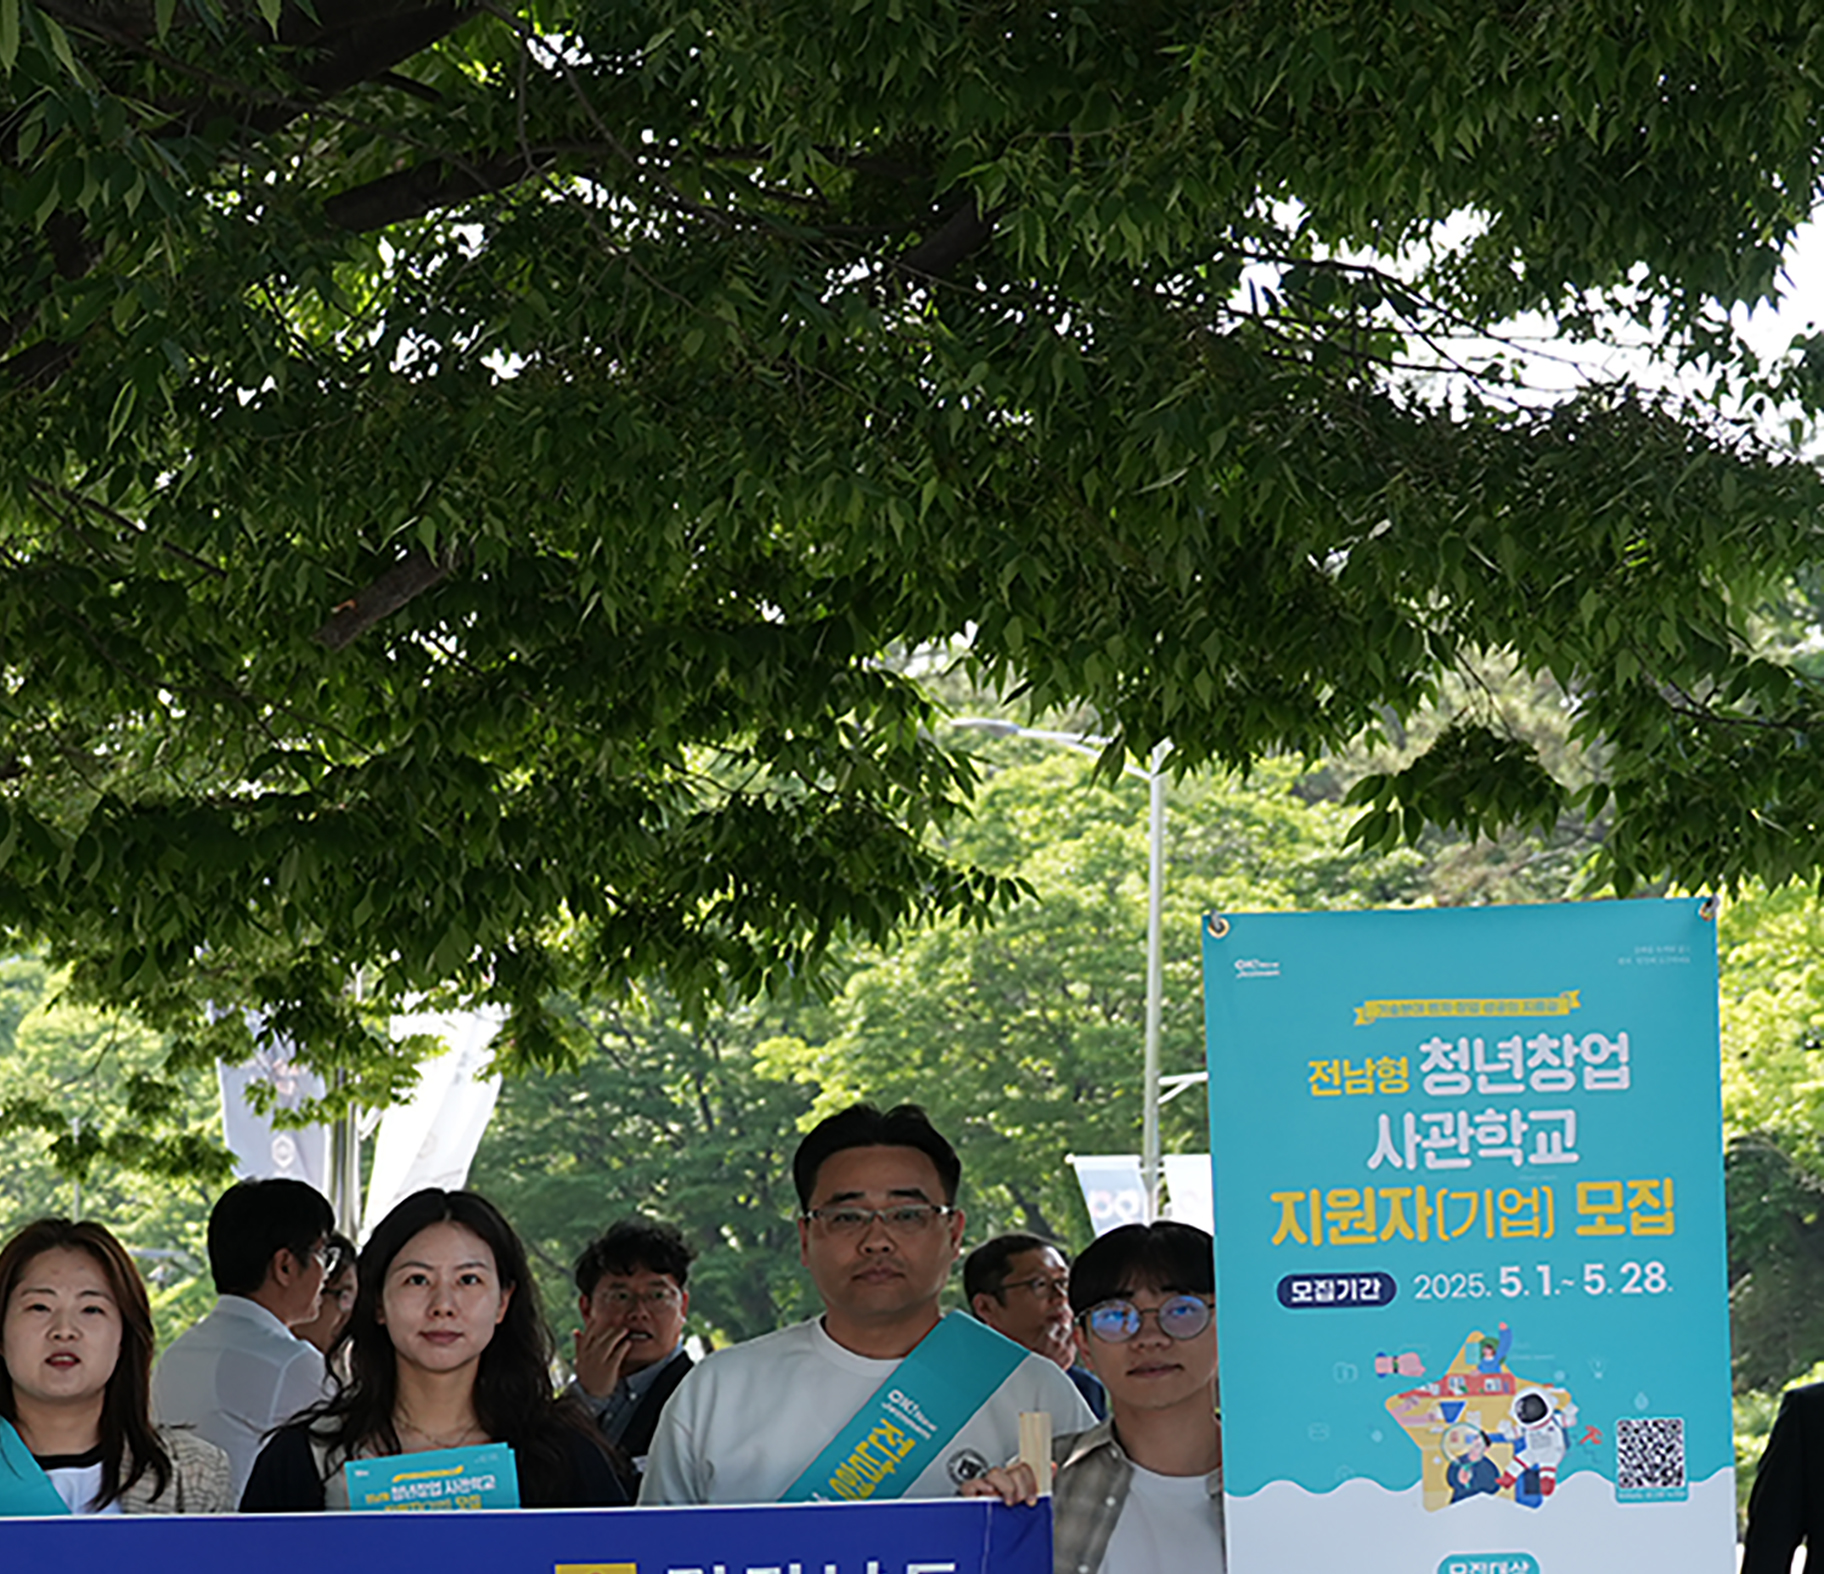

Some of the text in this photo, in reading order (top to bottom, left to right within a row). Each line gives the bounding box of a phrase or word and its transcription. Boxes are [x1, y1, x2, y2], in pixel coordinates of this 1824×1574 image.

[1309, 1032, 1630, 1096] 전남형 청년창업
[1368, 1108, 1579, 1170] 사관학교
[1271, 1178, 1674, 1246] 지원자(기업) 모집
[1292, 1279, 1381, 1302] 모집기간
